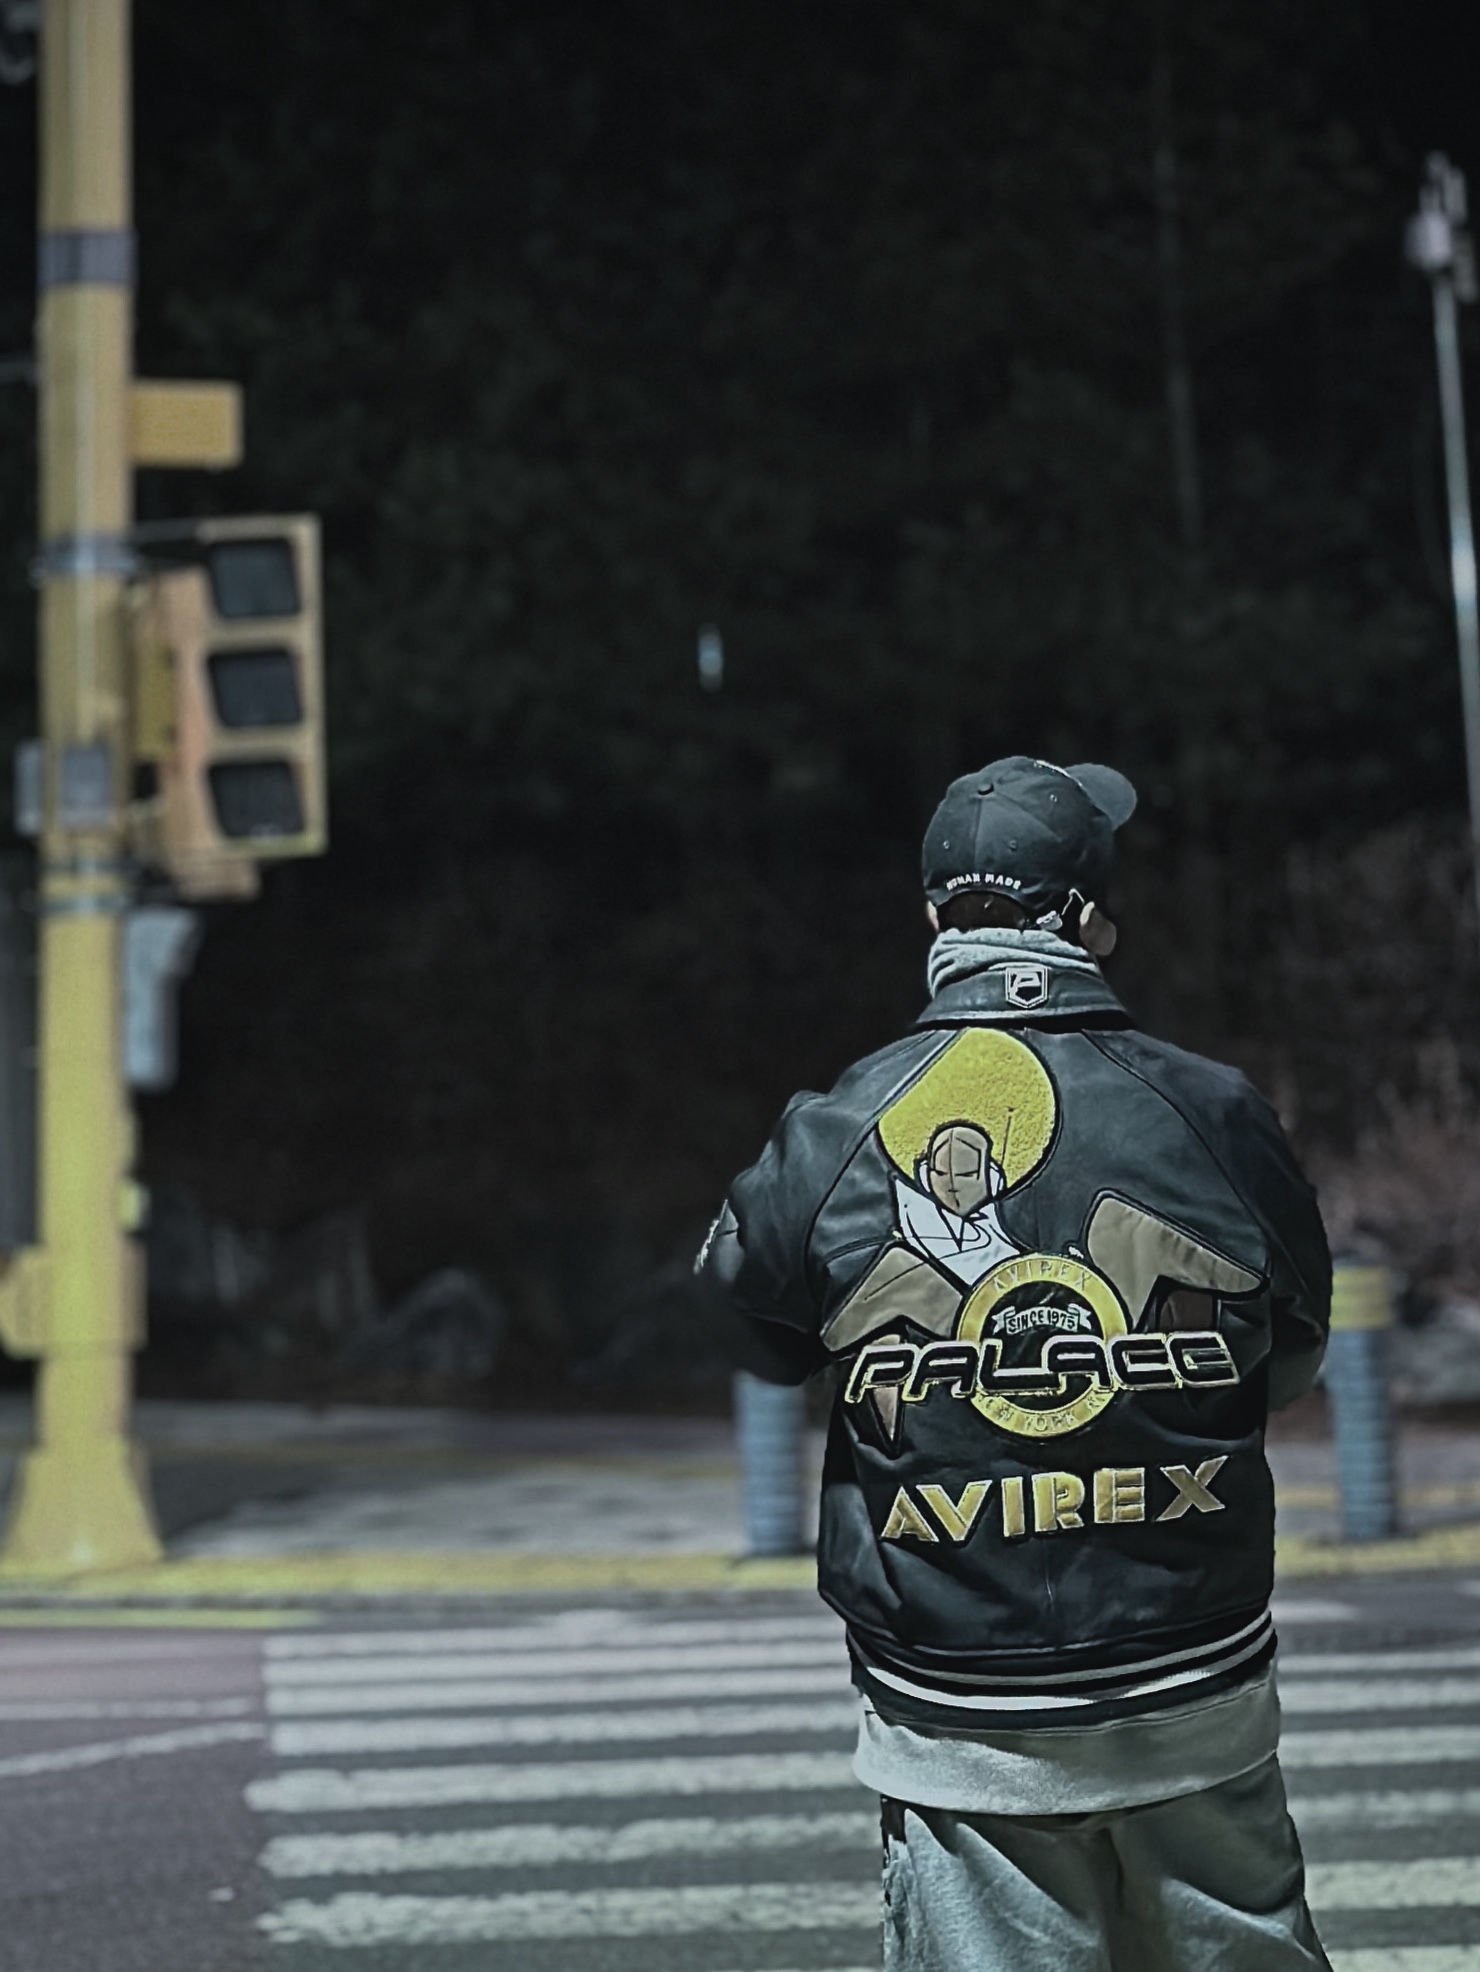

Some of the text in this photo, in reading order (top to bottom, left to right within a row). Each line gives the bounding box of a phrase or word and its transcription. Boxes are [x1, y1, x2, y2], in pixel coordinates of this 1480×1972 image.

[985, 873, 1021, 890] MADE
[993, 1260, 1092, 1291] AVIREX
[1008, 1309, 1076, 1333] SINCE 1975
[844, 1330, 1241, 1404] PALACE
[880, 1454, 1230, 1543] AVIREX
